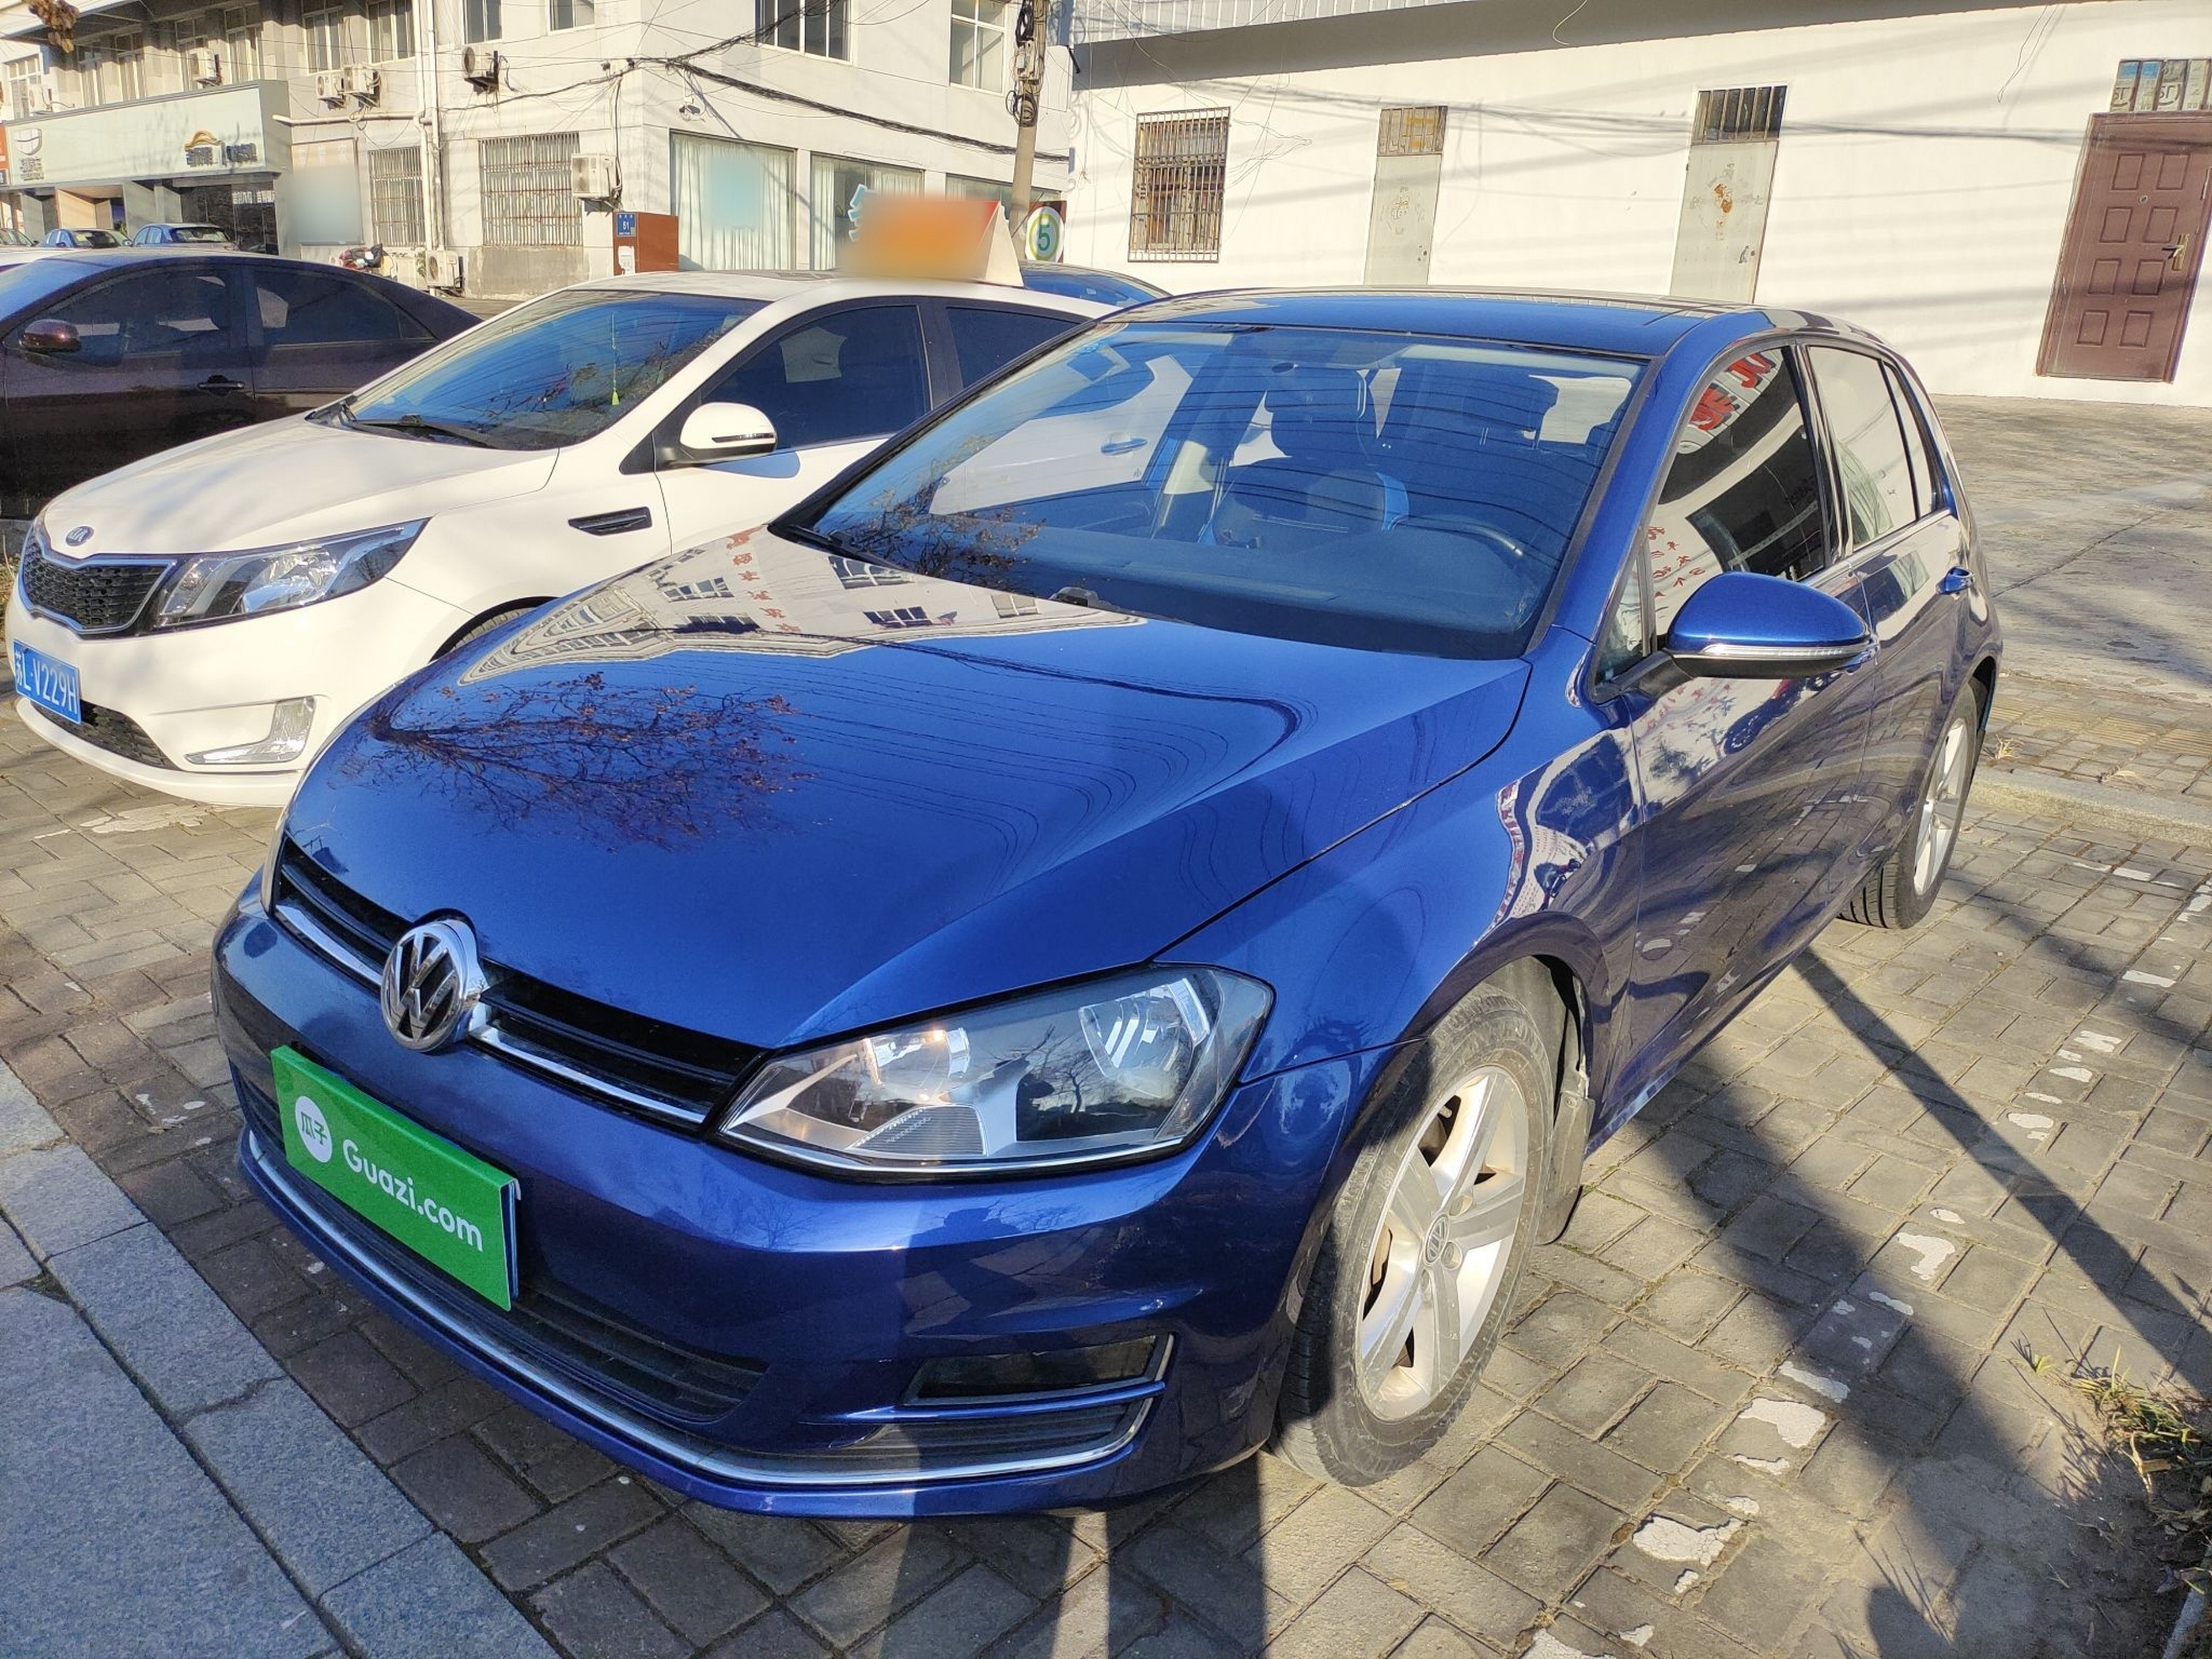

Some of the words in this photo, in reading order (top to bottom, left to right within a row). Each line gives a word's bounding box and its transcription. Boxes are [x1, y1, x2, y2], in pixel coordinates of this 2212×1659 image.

[622, 221, 630, 230] 51
[1037, 224, 1051, 251] 5
[301, 1111, 328, 1146] 瓜子
[342, 1138, 484, 1253] Guazi.com
